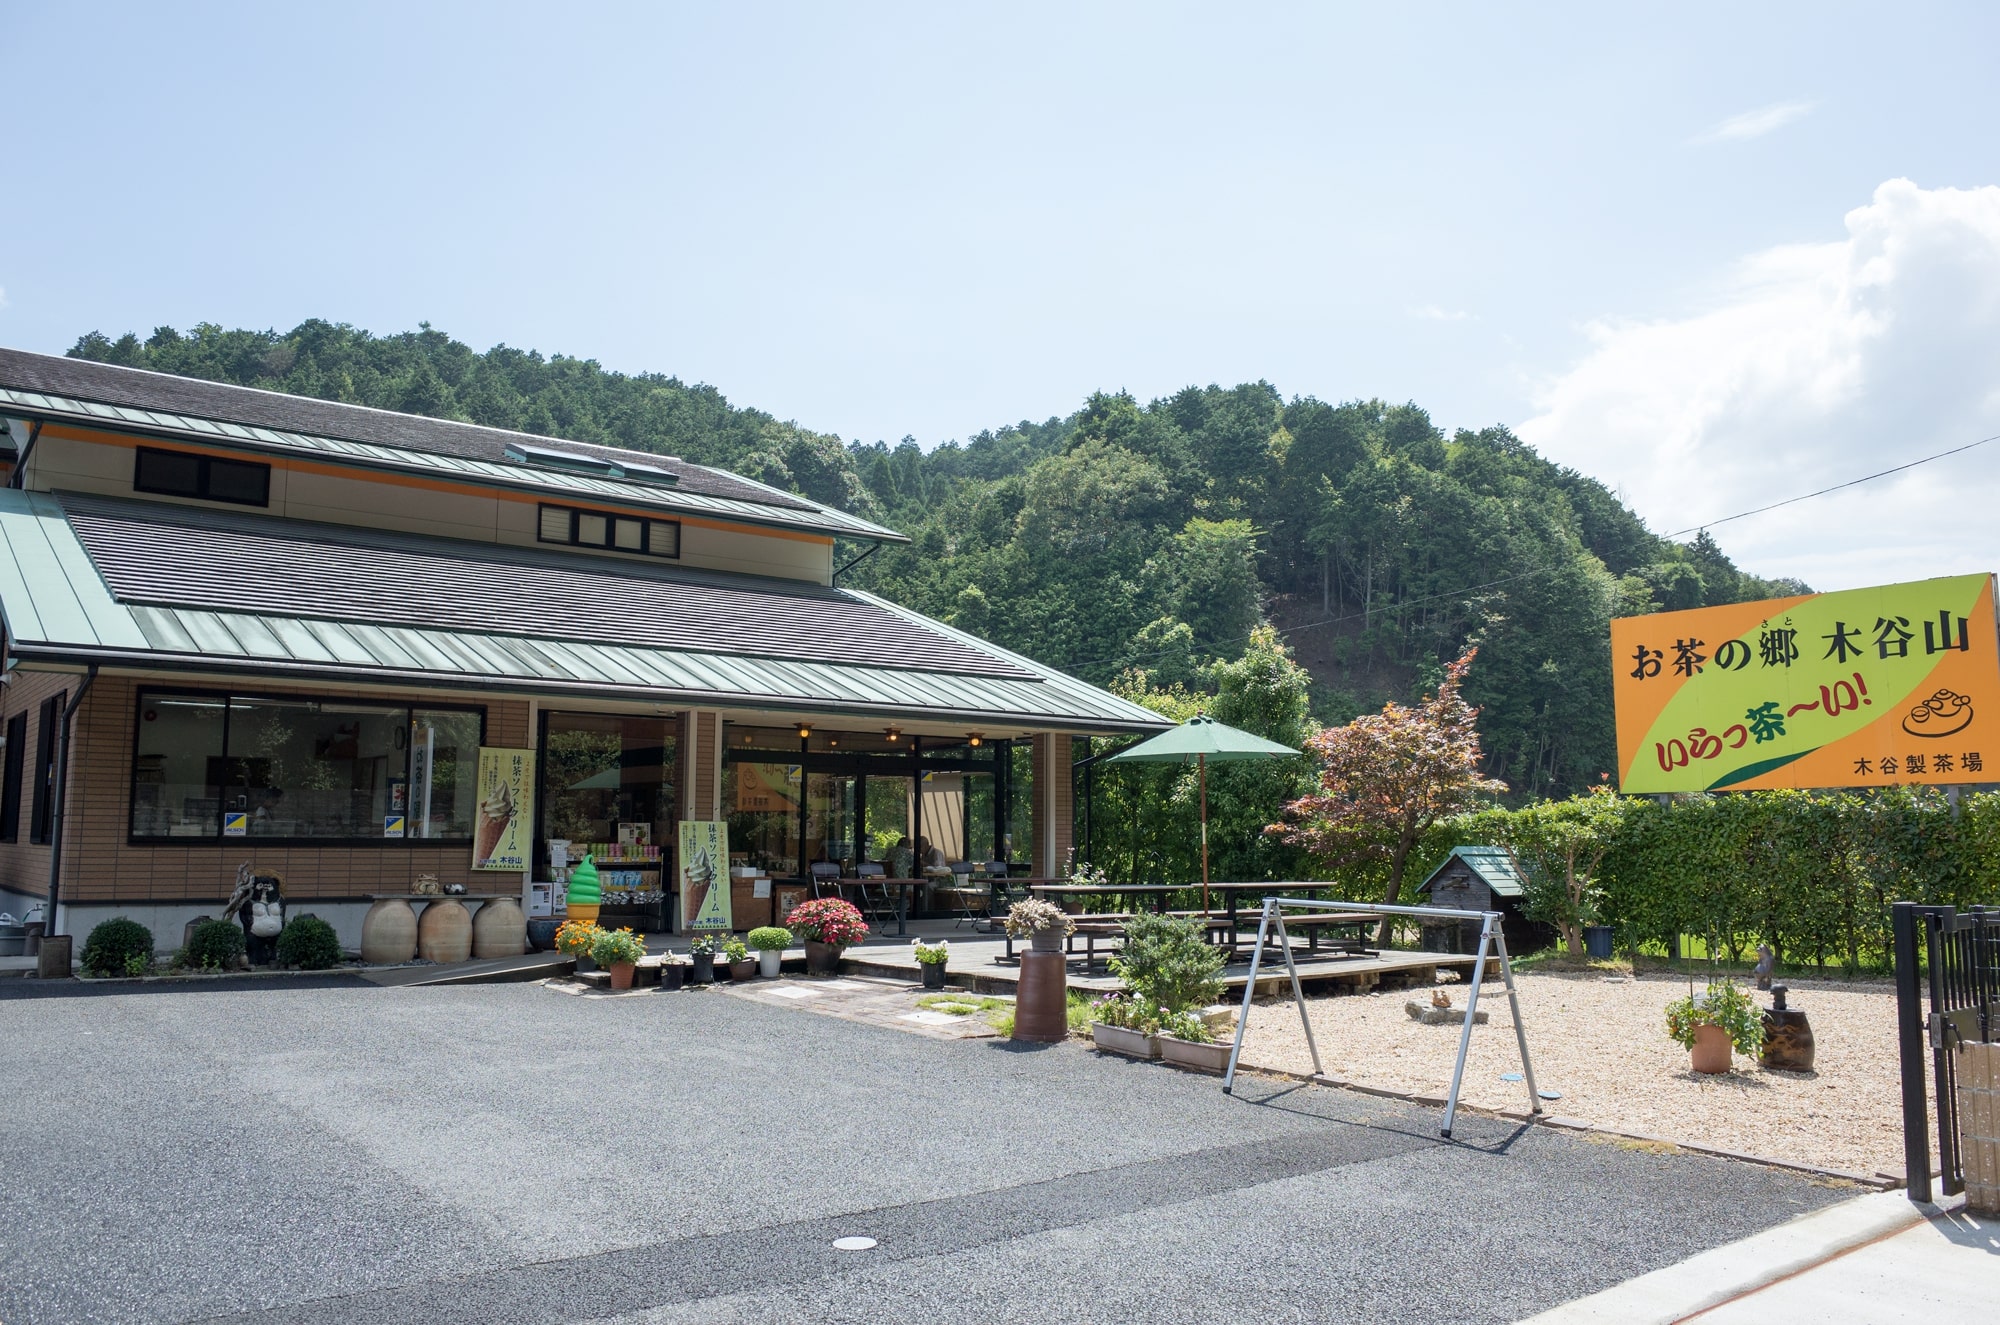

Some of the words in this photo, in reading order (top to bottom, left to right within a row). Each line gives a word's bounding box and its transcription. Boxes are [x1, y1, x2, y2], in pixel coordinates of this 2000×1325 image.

[1630, 628, 1799, 681] お茶の郷
[1821, 609, 1970, 664] 木谷山
[1760, 616, 1793, 629] さと
[1853, 752, 1983, 776] 木谷製茶場
[508, 755, 523, 851] 抹茶ソフトクリーム
[499, 856, 523, 864] 木谷山
[708, 823, 720, 912] 抹茶ソフトクリーム
